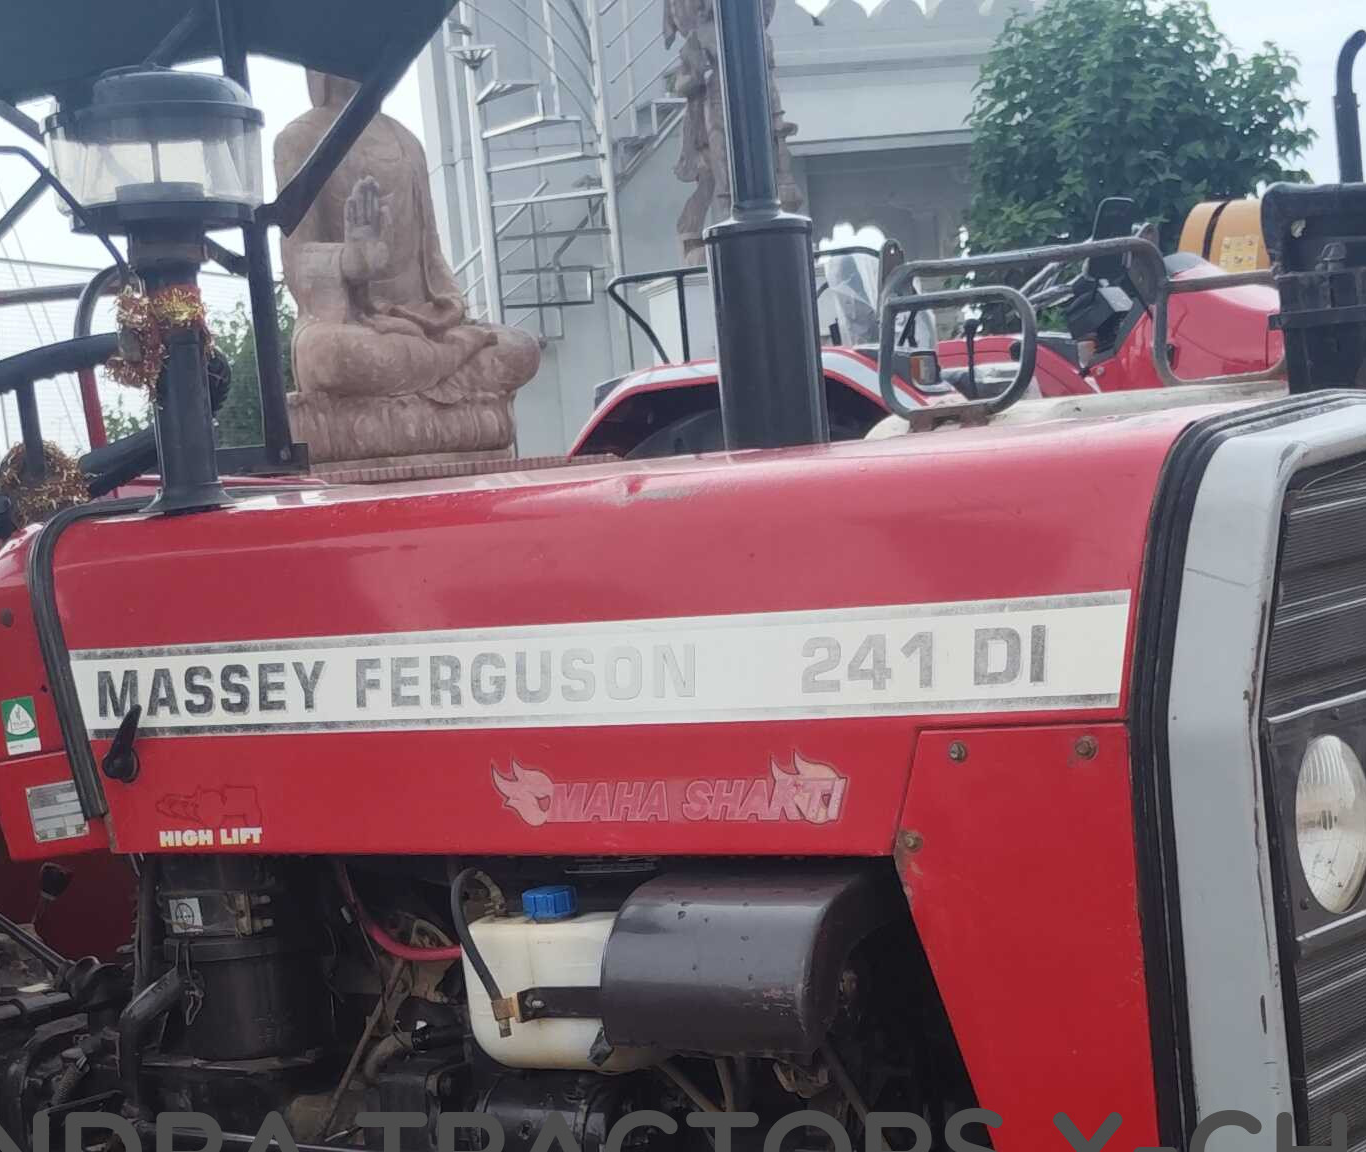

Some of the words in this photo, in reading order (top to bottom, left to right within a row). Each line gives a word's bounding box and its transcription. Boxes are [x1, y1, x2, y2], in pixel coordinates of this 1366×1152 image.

[97, 658, 327, 720] MASSEY
[355, 642, 697, 711] FERGUSON
[800, 630, 934, 694] 241
[973, 624, 1047, 687] DI
[159, 830, 214, 848] HIGH
[219, 827, 263, 845] LIFT
